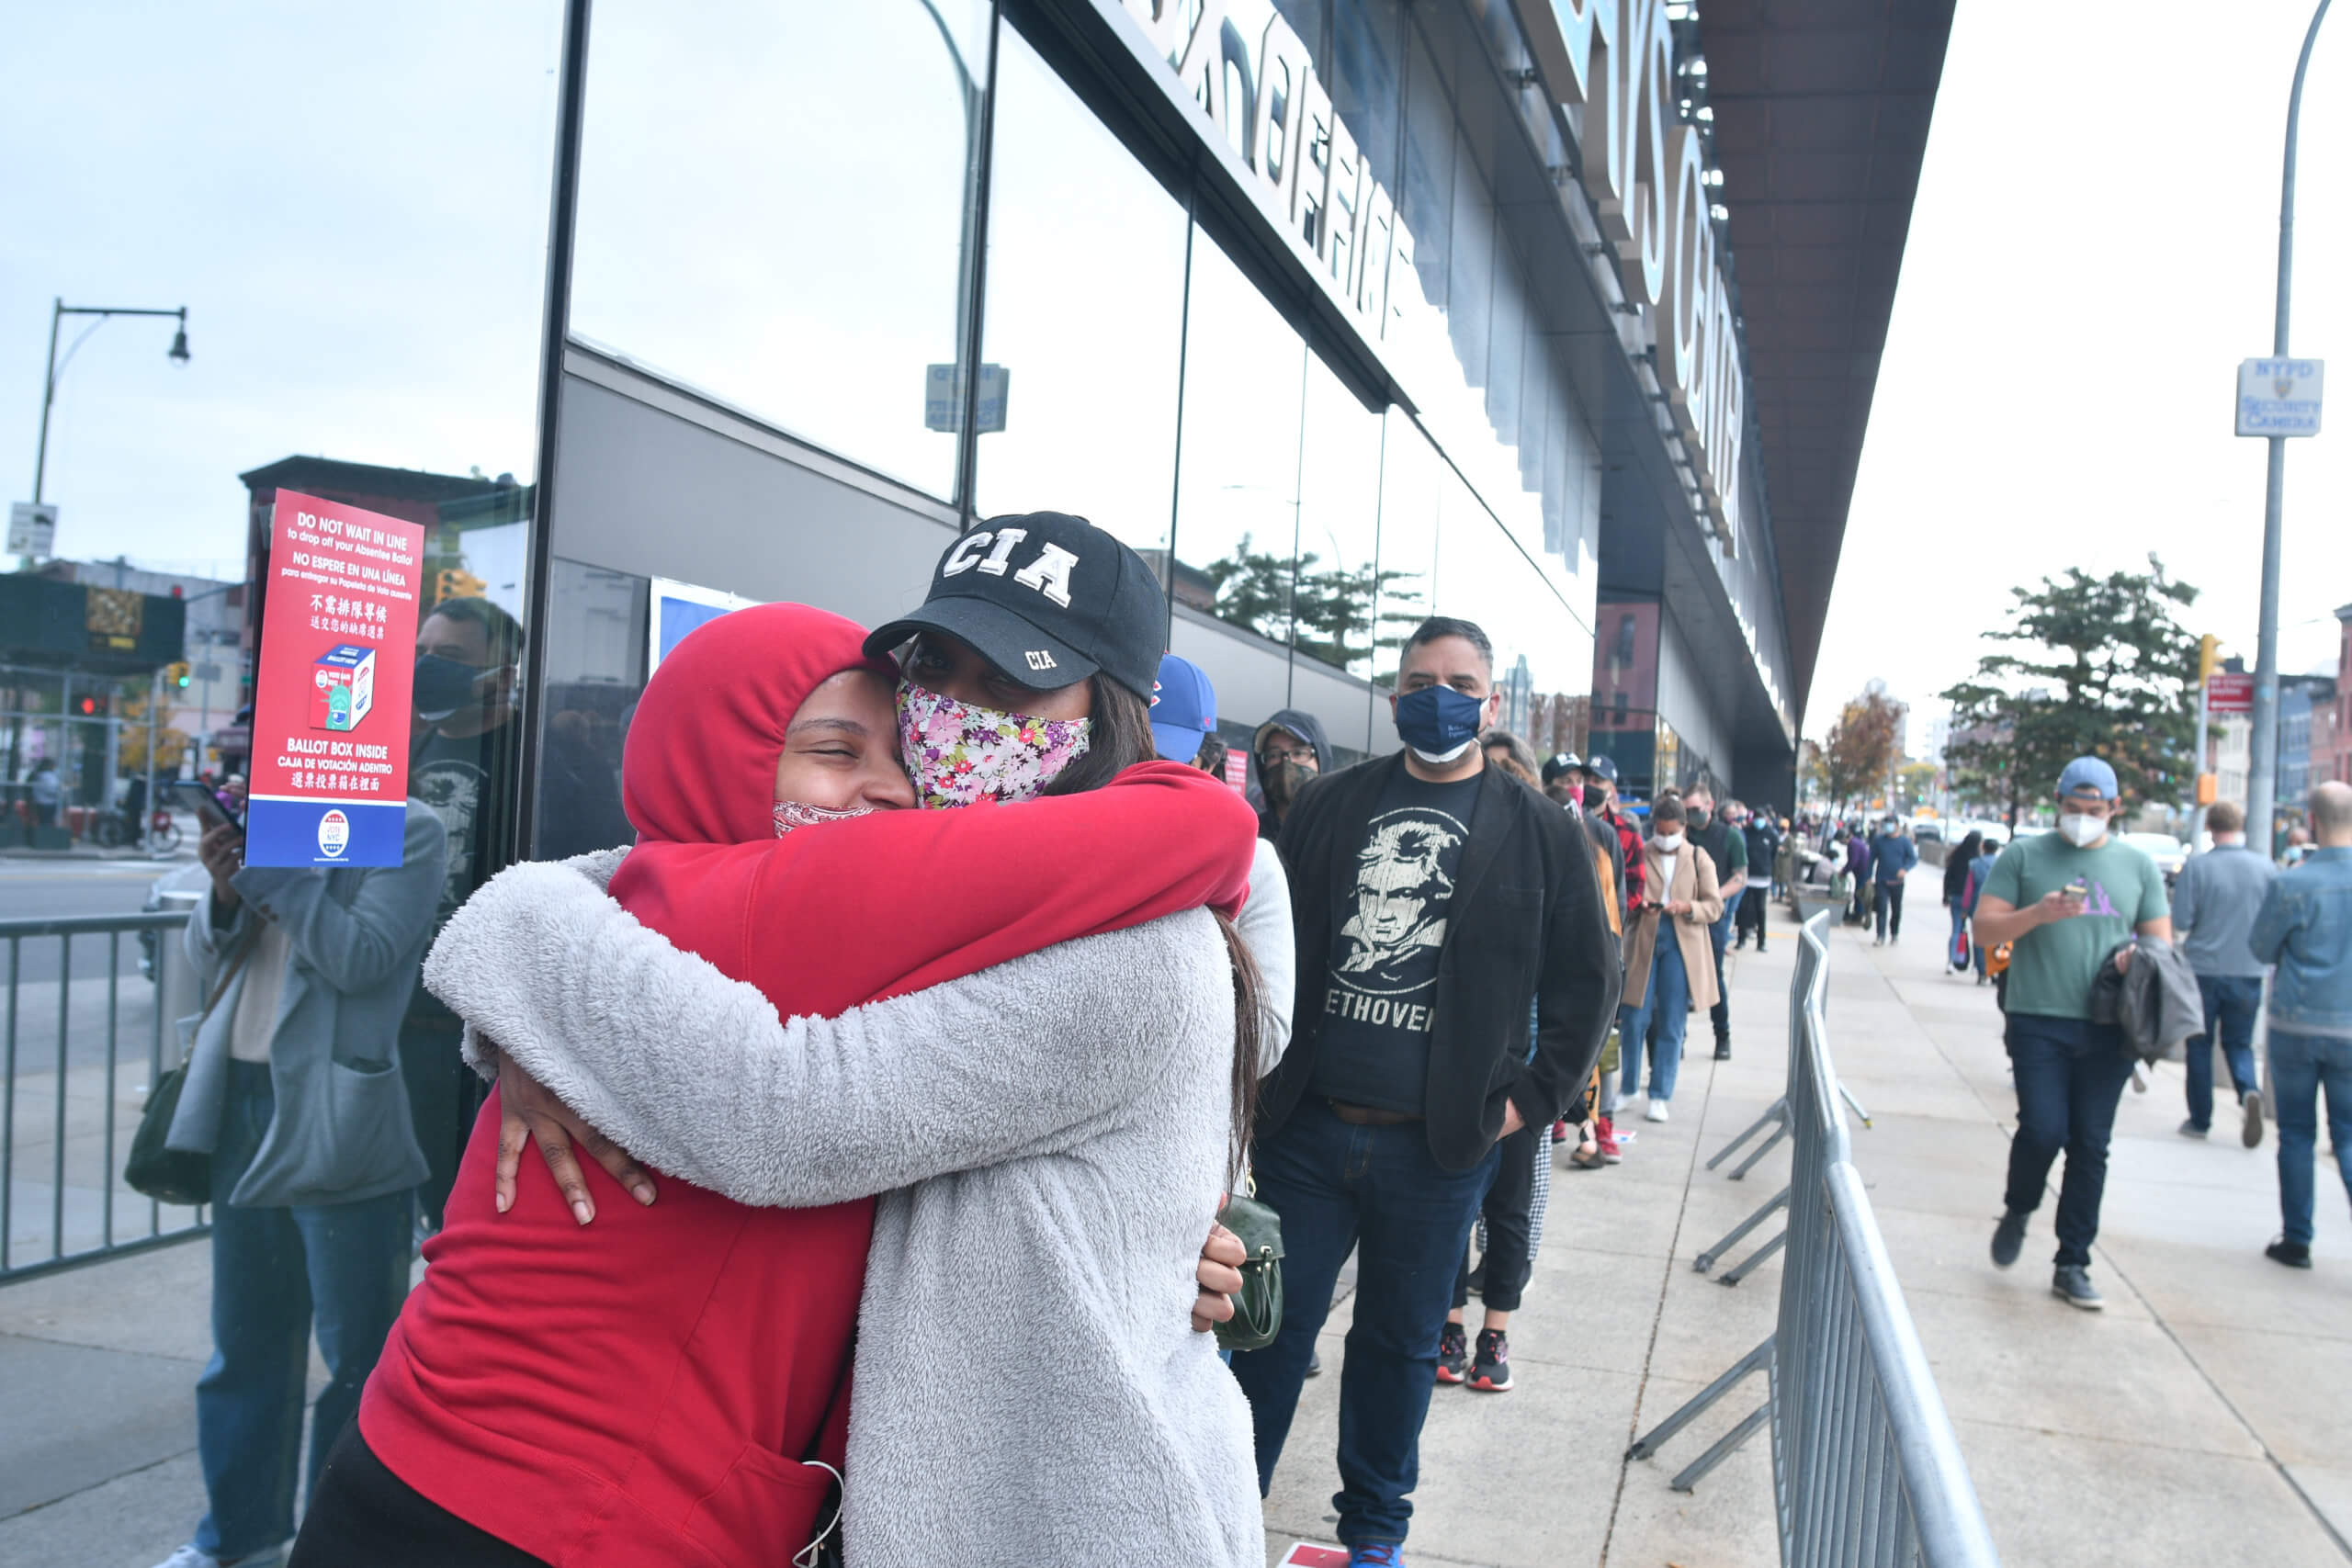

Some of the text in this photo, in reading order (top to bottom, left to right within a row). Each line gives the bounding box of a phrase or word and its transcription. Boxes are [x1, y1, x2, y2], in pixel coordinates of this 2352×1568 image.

[288, 527, 413, 566] to drop off your Absentee Ballot
[297, 512, 407, 550] DO NOT WAIT IN LINE
[281, 567, 300, 578] para
[292, 551, 406, 588] NO ESPERE EN UNA LÍNEA
[943, 527, 1080, 609] CIA
[310, 594, 388, 625] 不需排隊等候
[1024, 649, 1057, 671] CIA
[287, 738, 388, 760] BALLOT BOX INSIDE
[277, 756, 393, 774] CAJA DE VOTACIÓN ADENTRO
